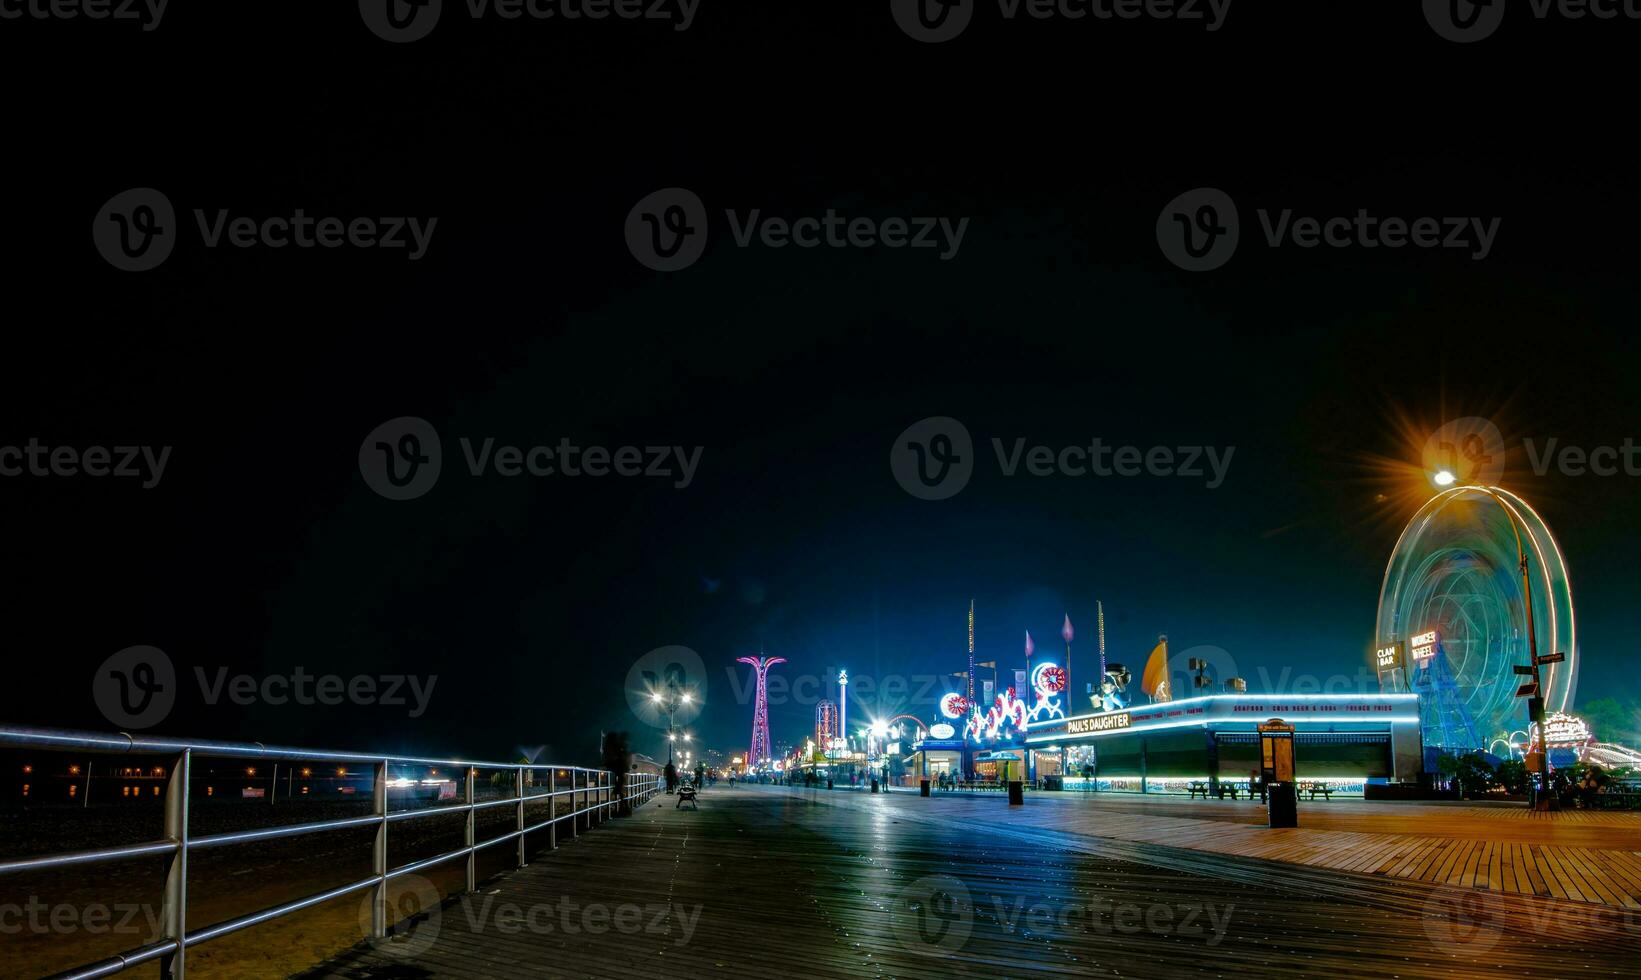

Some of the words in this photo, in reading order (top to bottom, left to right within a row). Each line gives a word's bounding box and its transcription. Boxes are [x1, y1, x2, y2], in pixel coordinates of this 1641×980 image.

[1377, 646, 1395, 658] CLAM
[1380, 655, 1394, 666] BAR
[1067, 718, 1089, 733] PAUL'S
[1089, 713, 1129, 731] DAUGHTER
